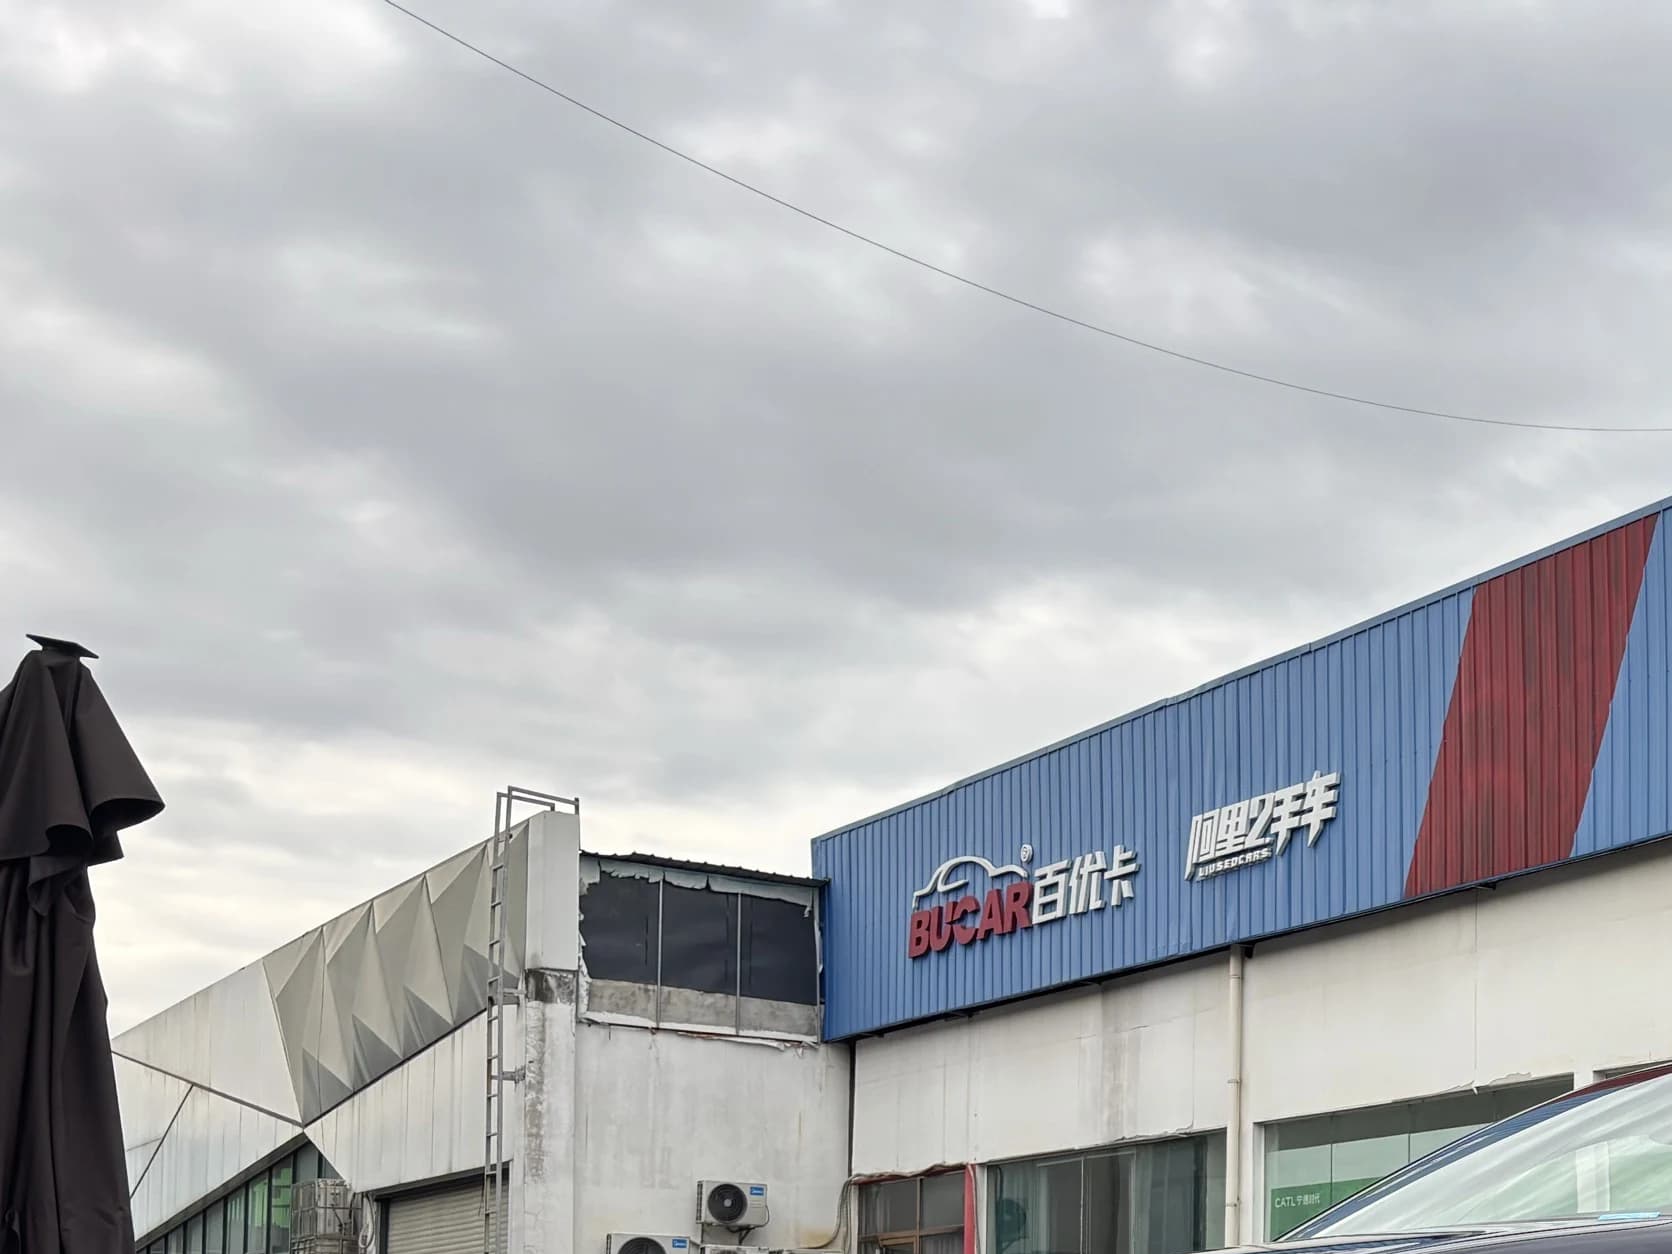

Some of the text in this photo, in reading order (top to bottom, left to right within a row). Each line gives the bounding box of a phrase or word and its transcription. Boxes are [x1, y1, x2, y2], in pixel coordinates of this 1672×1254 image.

[1184, 770, 1341, 881] 阿里2手车
[908, 844, 1140, 959] BUCAR 百优卡
[1275, 1196, 1296, 1208] CATL
